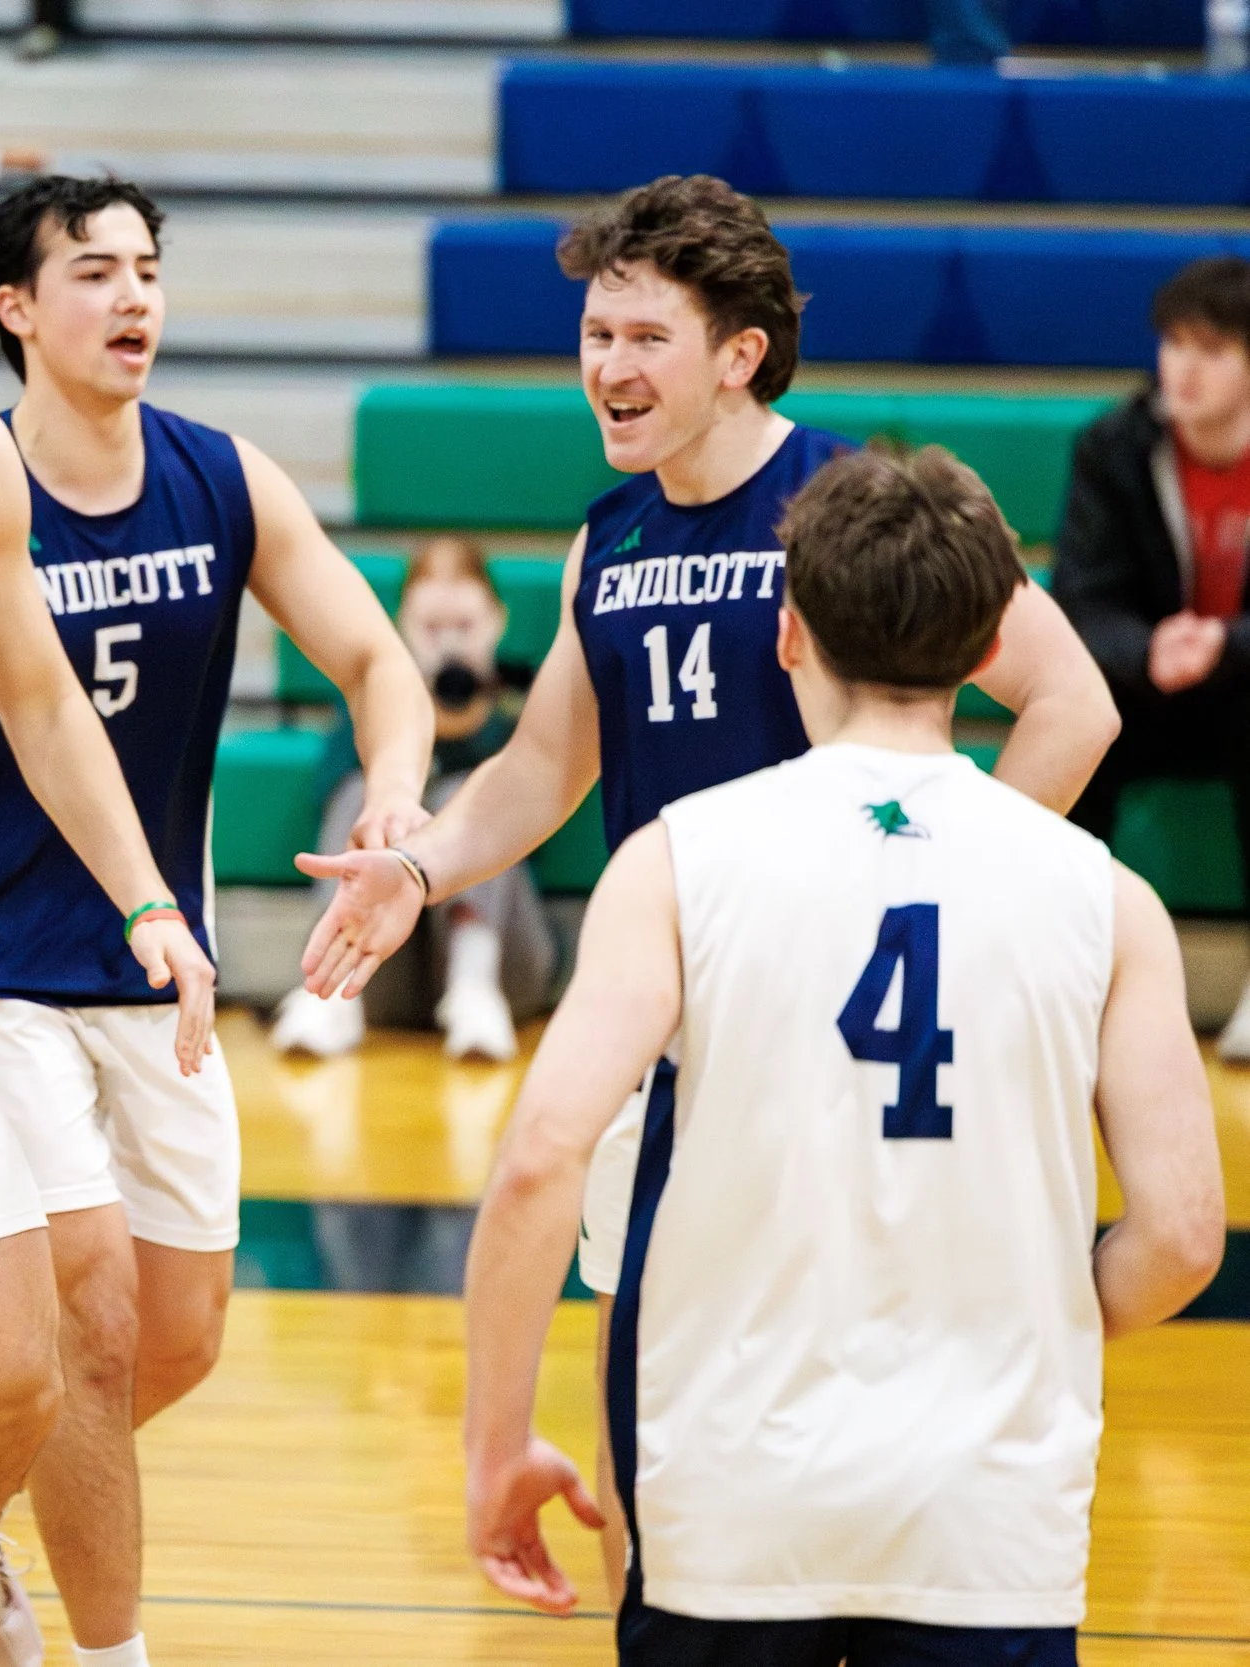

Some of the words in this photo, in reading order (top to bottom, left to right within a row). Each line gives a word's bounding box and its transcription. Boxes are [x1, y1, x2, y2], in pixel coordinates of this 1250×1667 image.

[33, 543, 216, 615] NDICOTT
[593, 550, 787, 615] ENDICOTT
[92, 623, 142, 718] 5
[643, 622, 718, 722] 14
[836, 903, 954, 1141] 4
